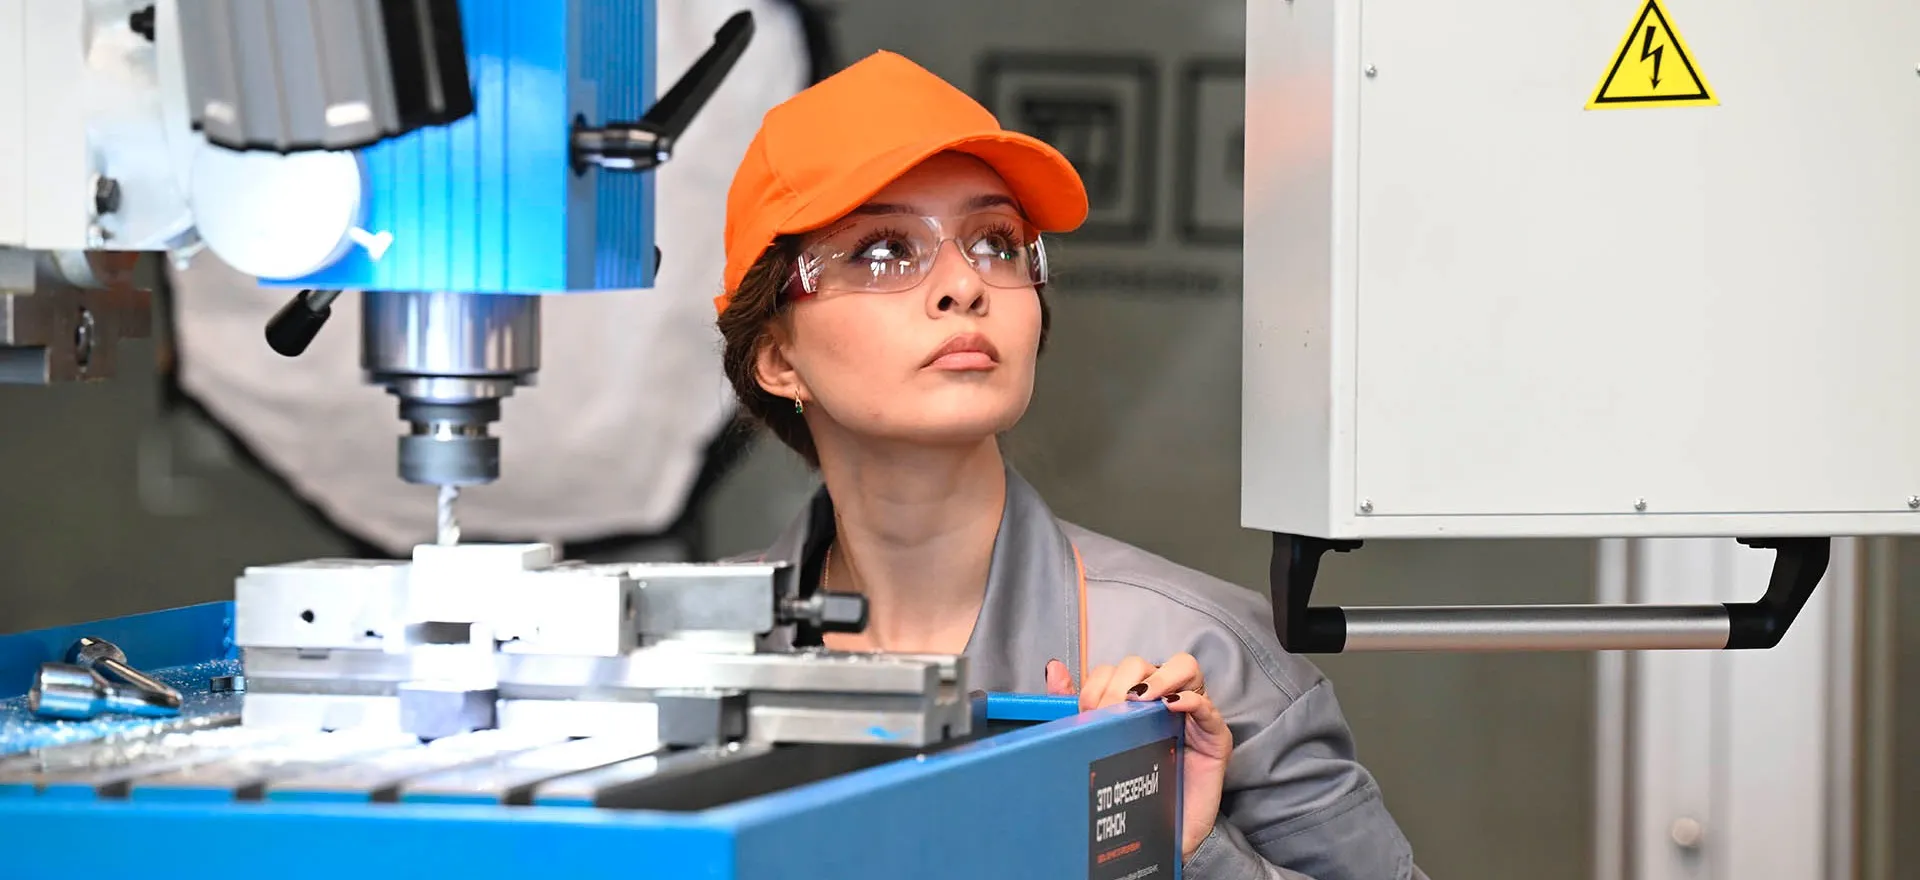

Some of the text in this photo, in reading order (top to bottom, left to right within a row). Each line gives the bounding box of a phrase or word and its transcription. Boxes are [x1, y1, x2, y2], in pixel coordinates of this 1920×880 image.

[1096, 763, 1159, 812] ЭТО ФРЕЗЕРНЫЙ
[1096, 811, 1126, 842] СТАНОК
